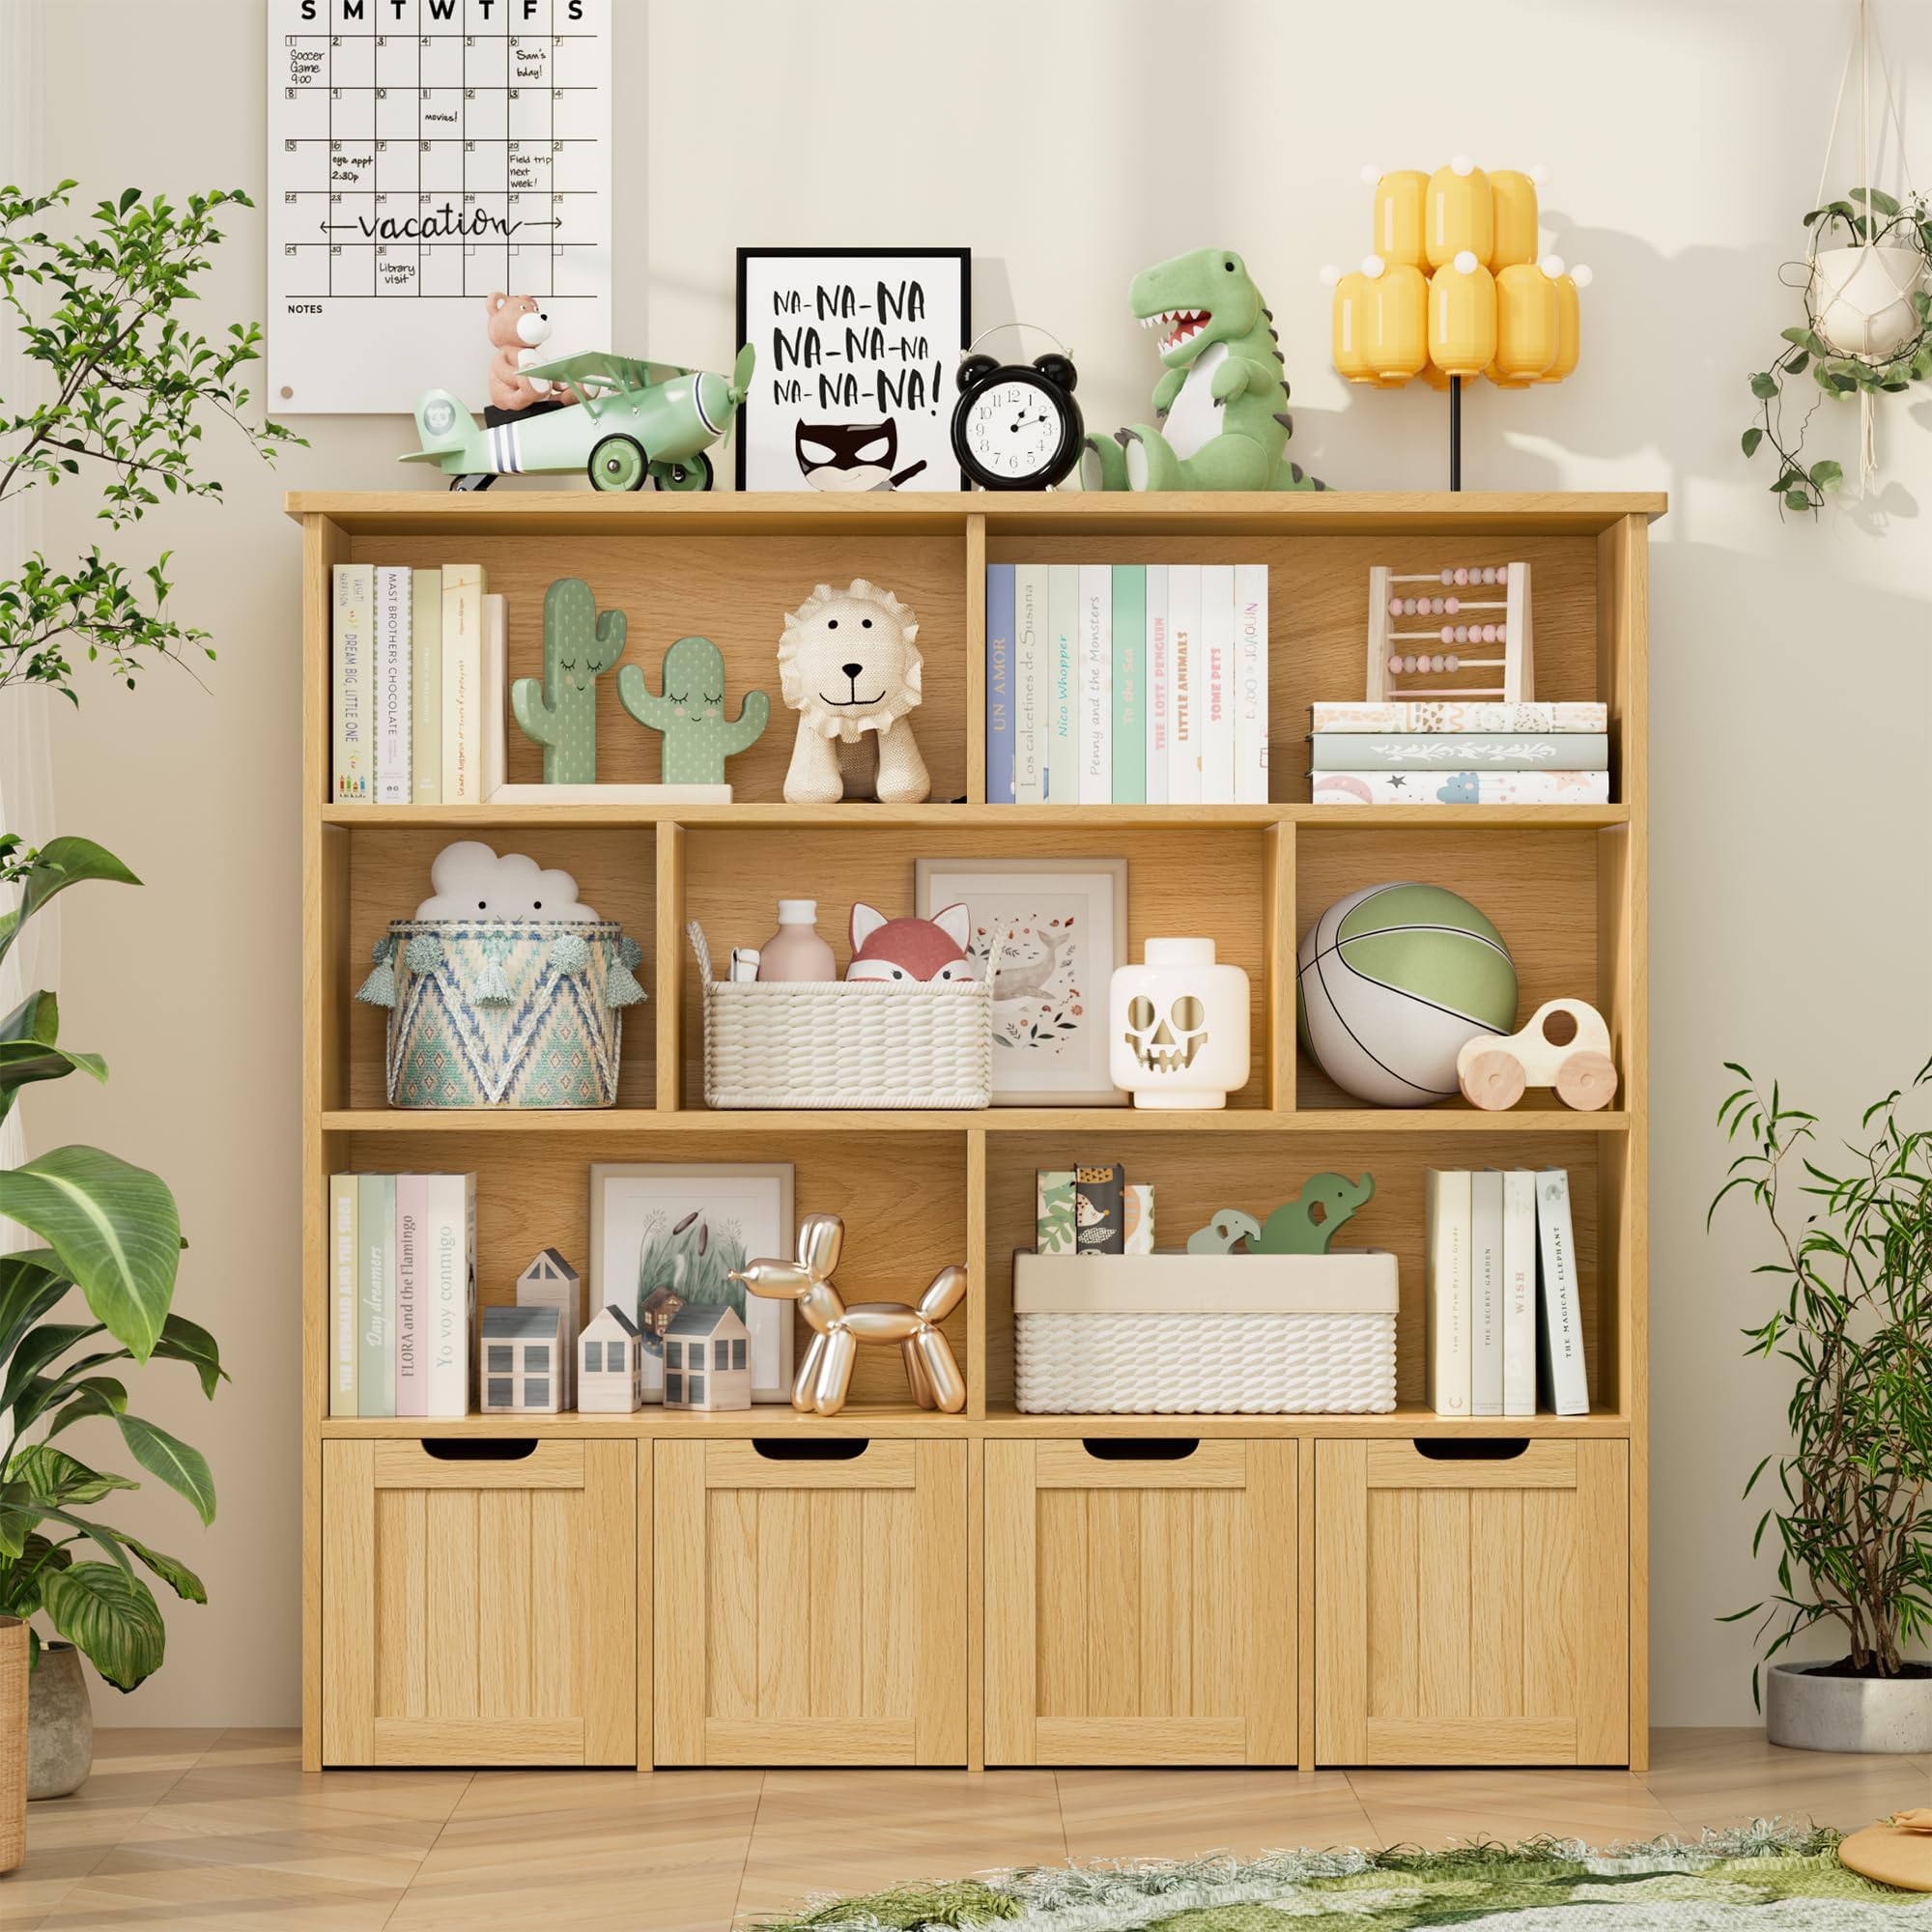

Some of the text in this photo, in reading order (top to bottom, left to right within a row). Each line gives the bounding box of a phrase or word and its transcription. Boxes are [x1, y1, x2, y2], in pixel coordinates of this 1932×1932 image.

[301, 0, 582, 19] S M T W T F S
[289, 37, 560, 45] 1 2 3 4 5 6 7
[290, 49, 325, 61] Soccer
[516, 48, 546, 61] Sam's
[290, 61, 321, 73] Game
[516, 65, 542, 79] bday!
[291, 73, 312, 85] 9:00
[288, 89, 294, 98] 8
[332, 89, 339, 98] 9
[377, 89, 385, 98] 10
[425, 111, 458, 123] movies!
[287, 141, 296, 150] 15
[331, 141, 340, 150] 16
[376, 141, 384, 150] 17
[421, 141, 429, 150] 18
[466, 141, 472, 150] 19
[332, 156, 373, 168] eye appt
[509, 155, 553, 164] Field trip
[331, 171, 358, 184] 2:30p
[510, 167, 530, 176] next
[510, 178, 537, 188] week!
[358, 202, 523, 239] vacation
[380, 263, 415, 276] Library
[384, 274, 409, 284] visit
[288, 304, 323, 314] NOTES
[993, 394, 1002, 408] 11
[1008, 389, 1020, 403] 12
[1028, 393, 1033, 407] 1
[980, 407, 993, 420] 10
[976, 423, 985, 436] 9
[1042, 423, 1052, 436] 3
[980, 440, 989, 452] 8
[1036, 440, 1045, 451] 4
[993, 452, 1002, 465] 7
[1009, 456, 1018, 469] 6
[1027, 451, 1036, 465] 5
[388, 573, 397, 602] MAST
[387, 606, 398, 665] BROTHERS
[343, 634, 358, 743] DREAM BIG, LITTLE ONE
[993, 638, 1007, 731] UN AMOR
[1019, 584, 1037, 787] Los calcetines de Susana
[1058, 634, 1070, 737] Nico Whopper
[1089, 596, 1103, 776] Penny and the Monsters
[1153, 617, 1166, 751] THE LOST PENGUIN
[1177, 631, 1188, 742] LITTLE ANIMALS
[1210, 648, 1222, 722] SOME PETS
[387, 668, 398, 735] CHOCOLATE
[1553, 1226, 1565, 1281] ELEPHANT
[363, 1245, 386, 1348] Day dreamers
[400, 1214, 416, 1378] FLORA and the Flamingo
[437, 1225, 456, 1368] Yo voy conmigo
[1515, 1271, 1524, 1315] WISH
[1560, 1286, 1570, 1333] MAGICAL
